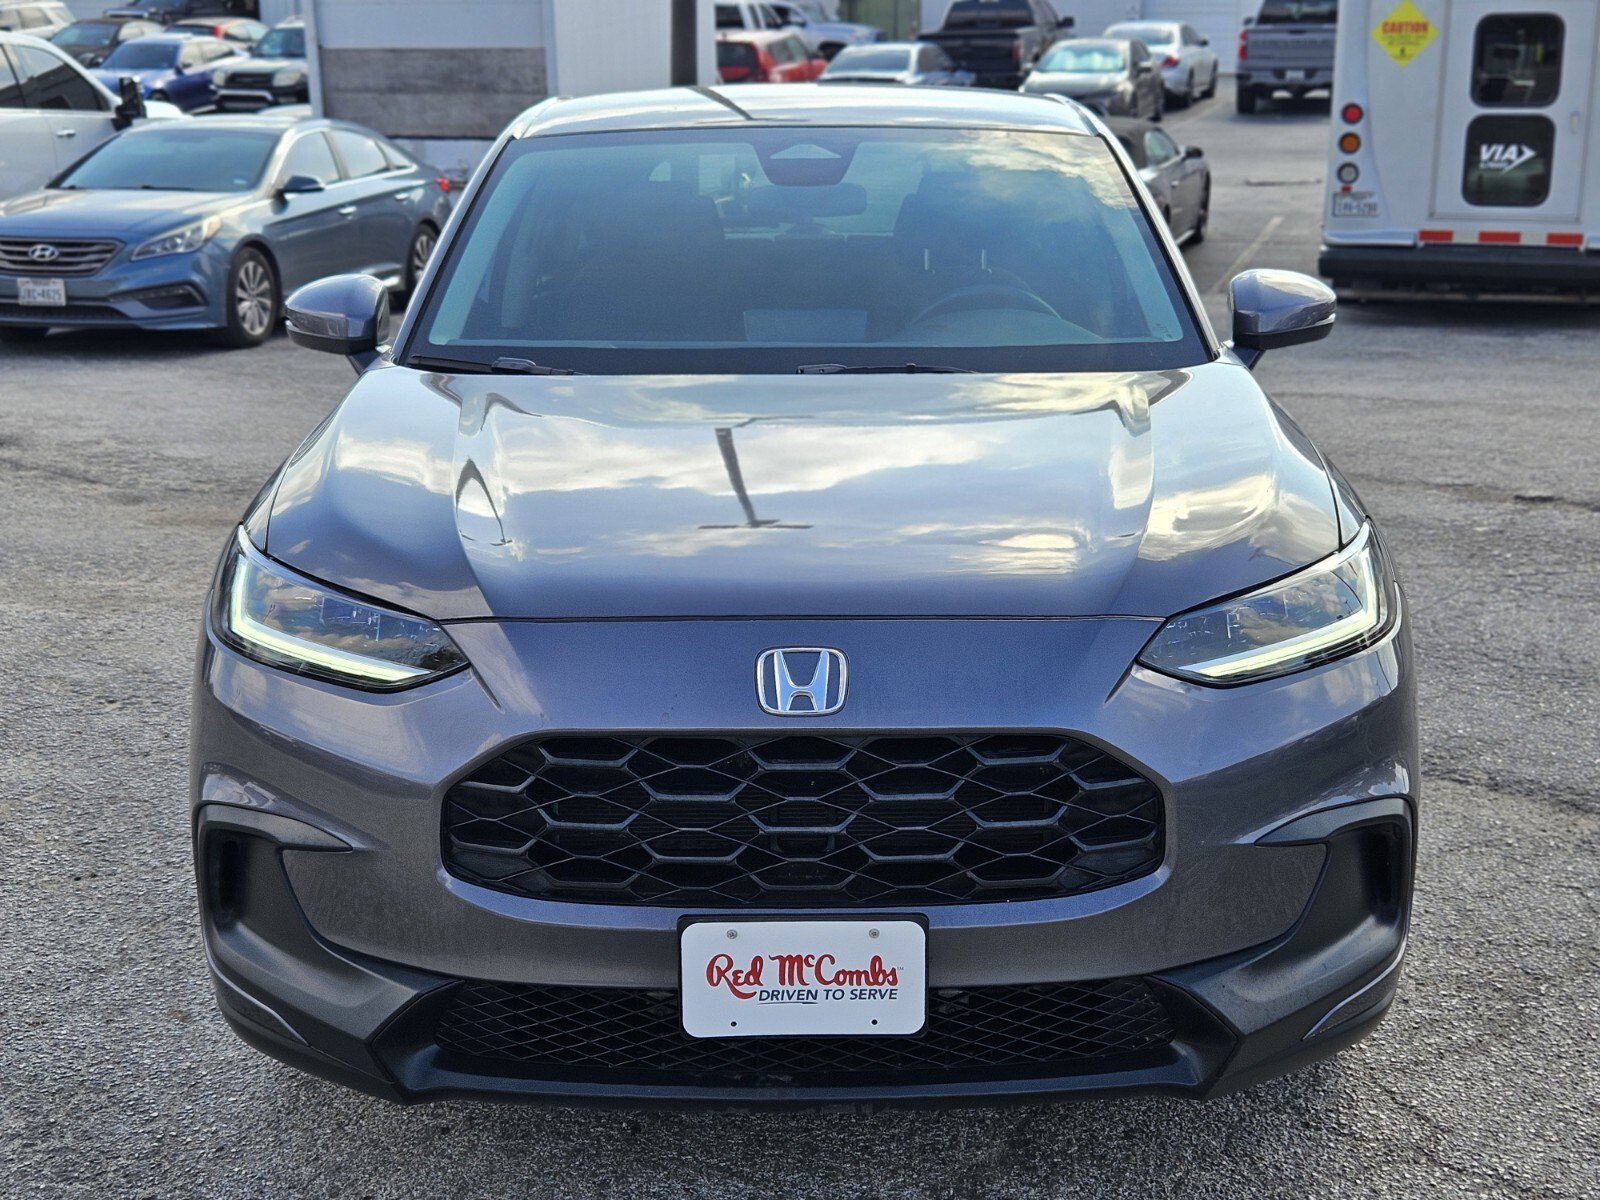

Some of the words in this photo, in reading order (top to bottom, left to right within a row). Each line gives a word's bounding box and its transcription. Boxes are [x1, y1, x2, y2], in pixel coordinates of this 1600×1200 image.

[1381, 21, 1428, 33] CAUTION
[1479, 143, 1518, 161] VIA
[706, 953, 764, 1000] Red
[768, 954, 898, 987] McCombs
[758, 989, 818, 1001] DRIVEN
[823, 989, 845, 1000] TO
[849, 988, 898, 1000] SERVE
